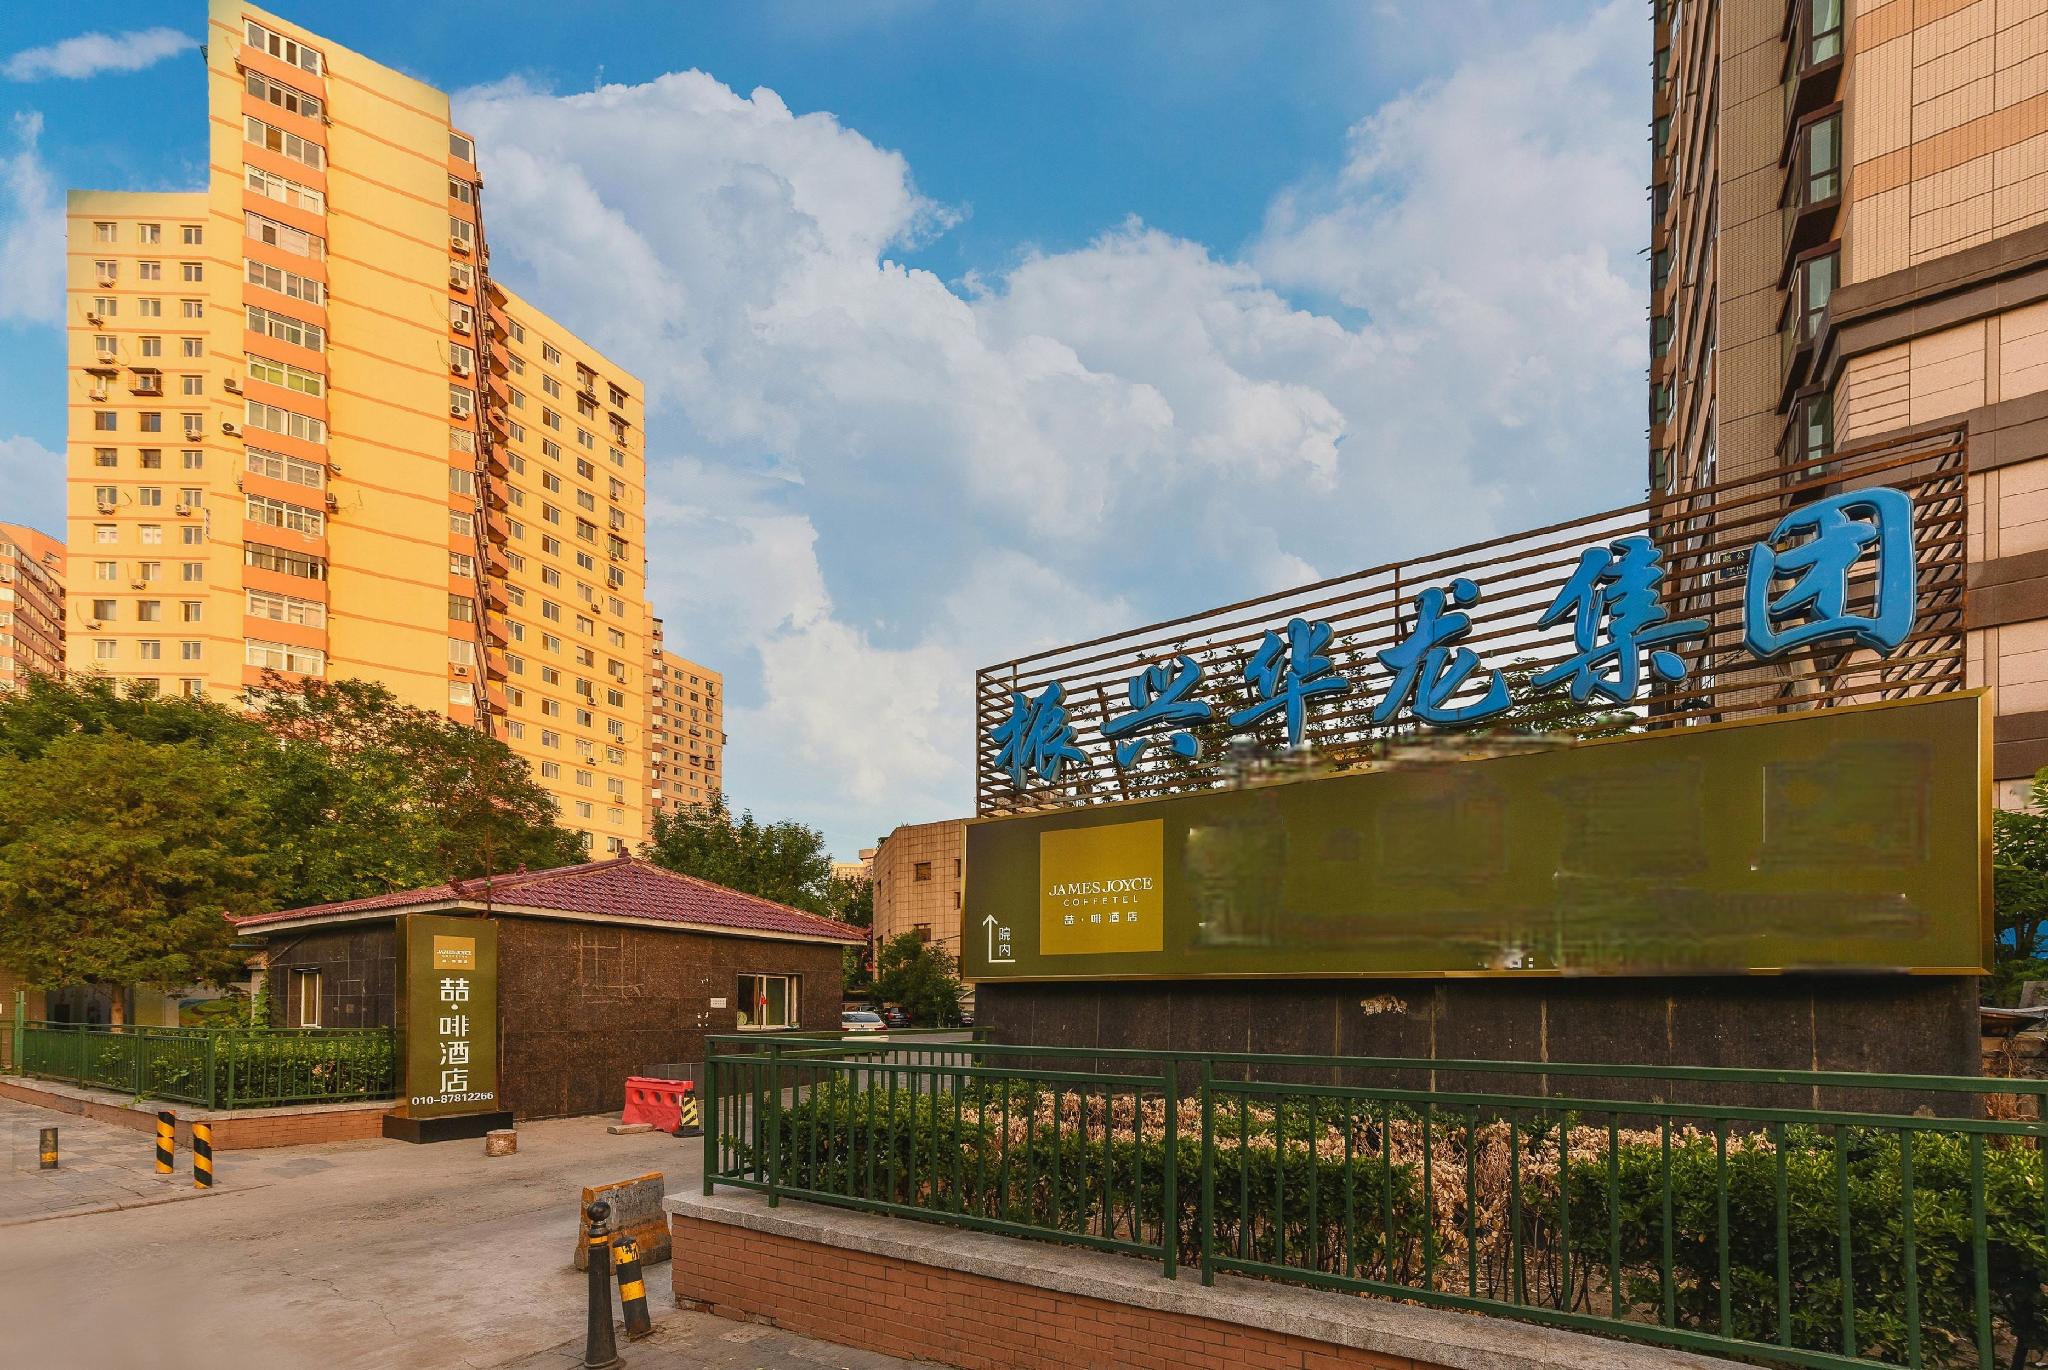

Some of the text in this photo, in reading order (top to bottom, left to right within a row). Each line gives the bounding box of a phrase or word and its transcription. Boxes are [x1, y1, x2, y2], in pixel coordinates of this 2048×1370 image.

[991, 486, 1917, 787] 振兴华龙集团
[1048, 877, 1153, 896] JAMES JOYCE
[1063, 895, 1139, 907] COFFETEL
[998, 926, 1011, 957] 院内
[412, 1092, 494, 1105] 010-87812266
